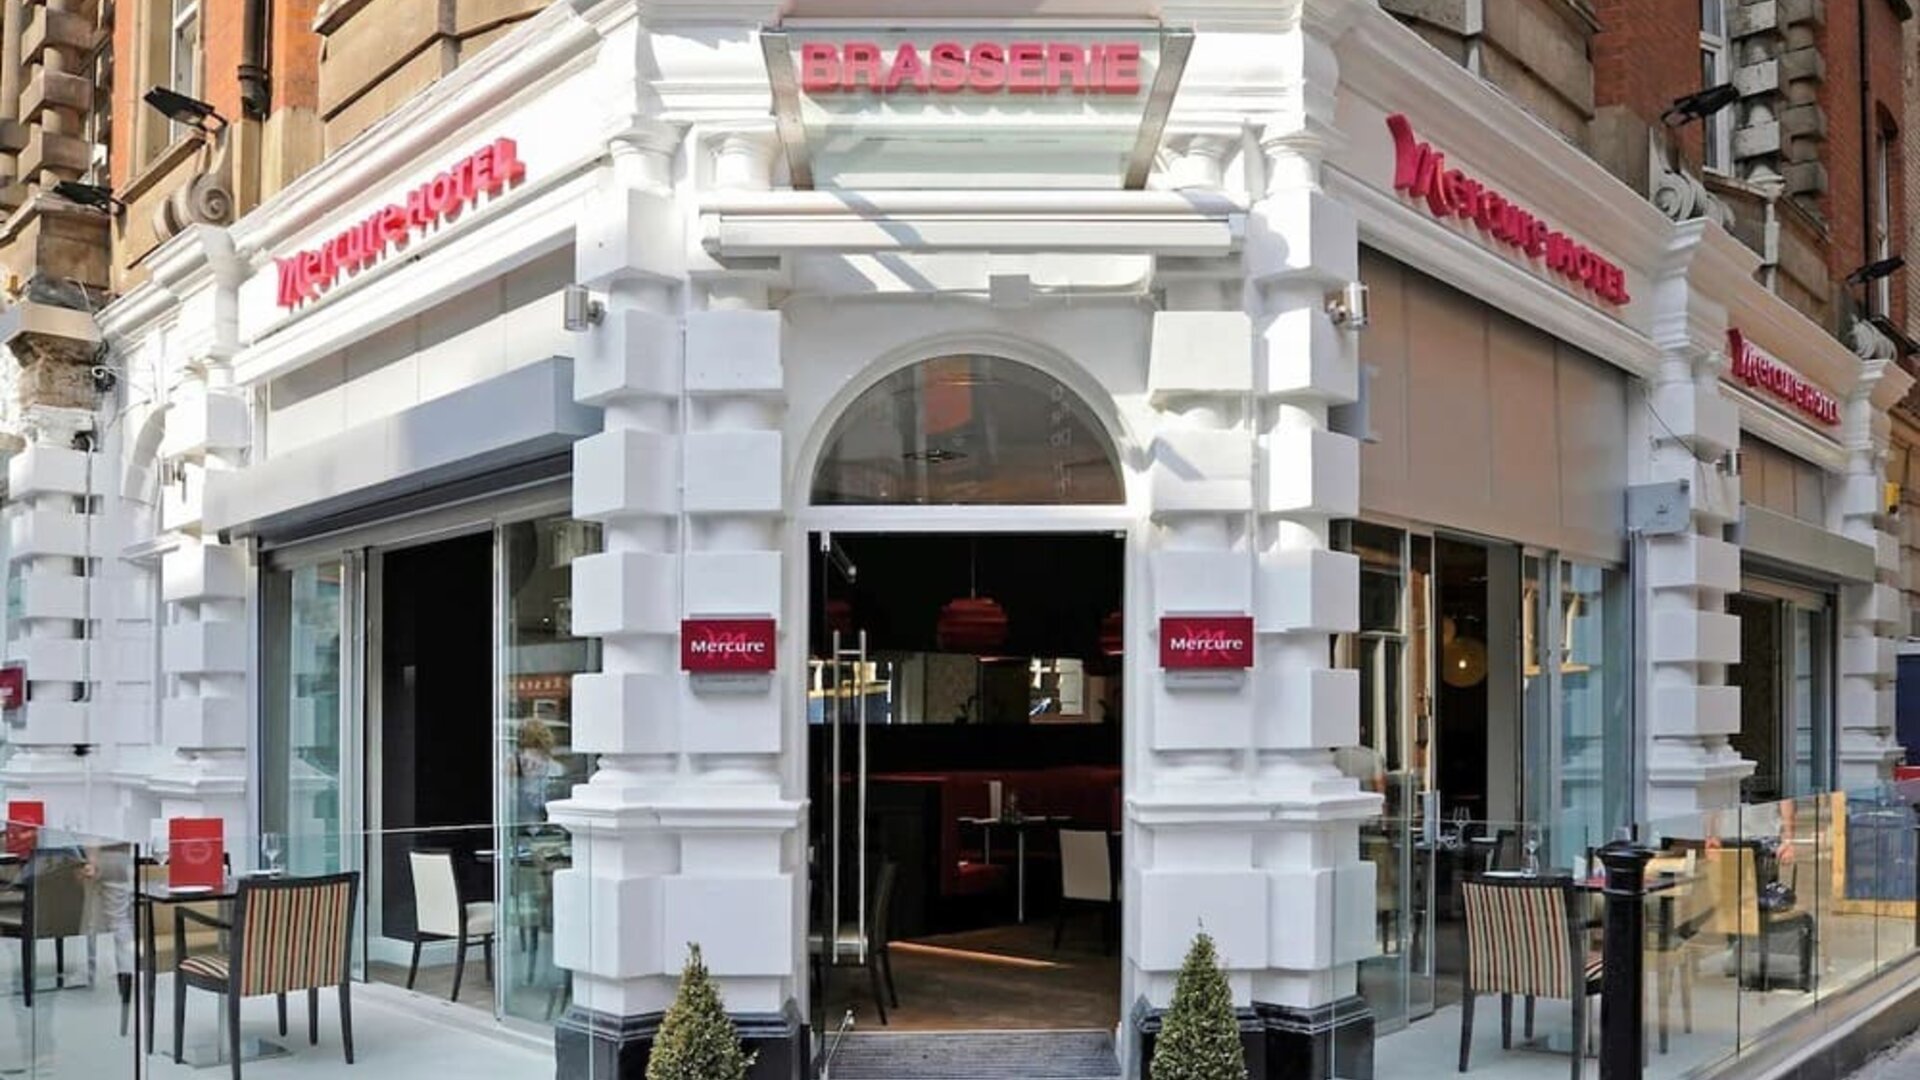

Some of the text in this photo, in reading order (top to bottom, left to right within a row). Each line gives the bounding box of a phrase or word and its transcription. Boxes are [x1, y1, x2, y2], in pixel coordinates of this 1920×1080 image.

[801, 43, 1140, 94] BRASSERIE
[274, 137, 526, 308] Mercure HOTEL
[1386, 114, 1631, 305] Mercure HOTEL
[691, 640, 764, 652] Mercure
[1170, 637, 1243, 650] Mercure
